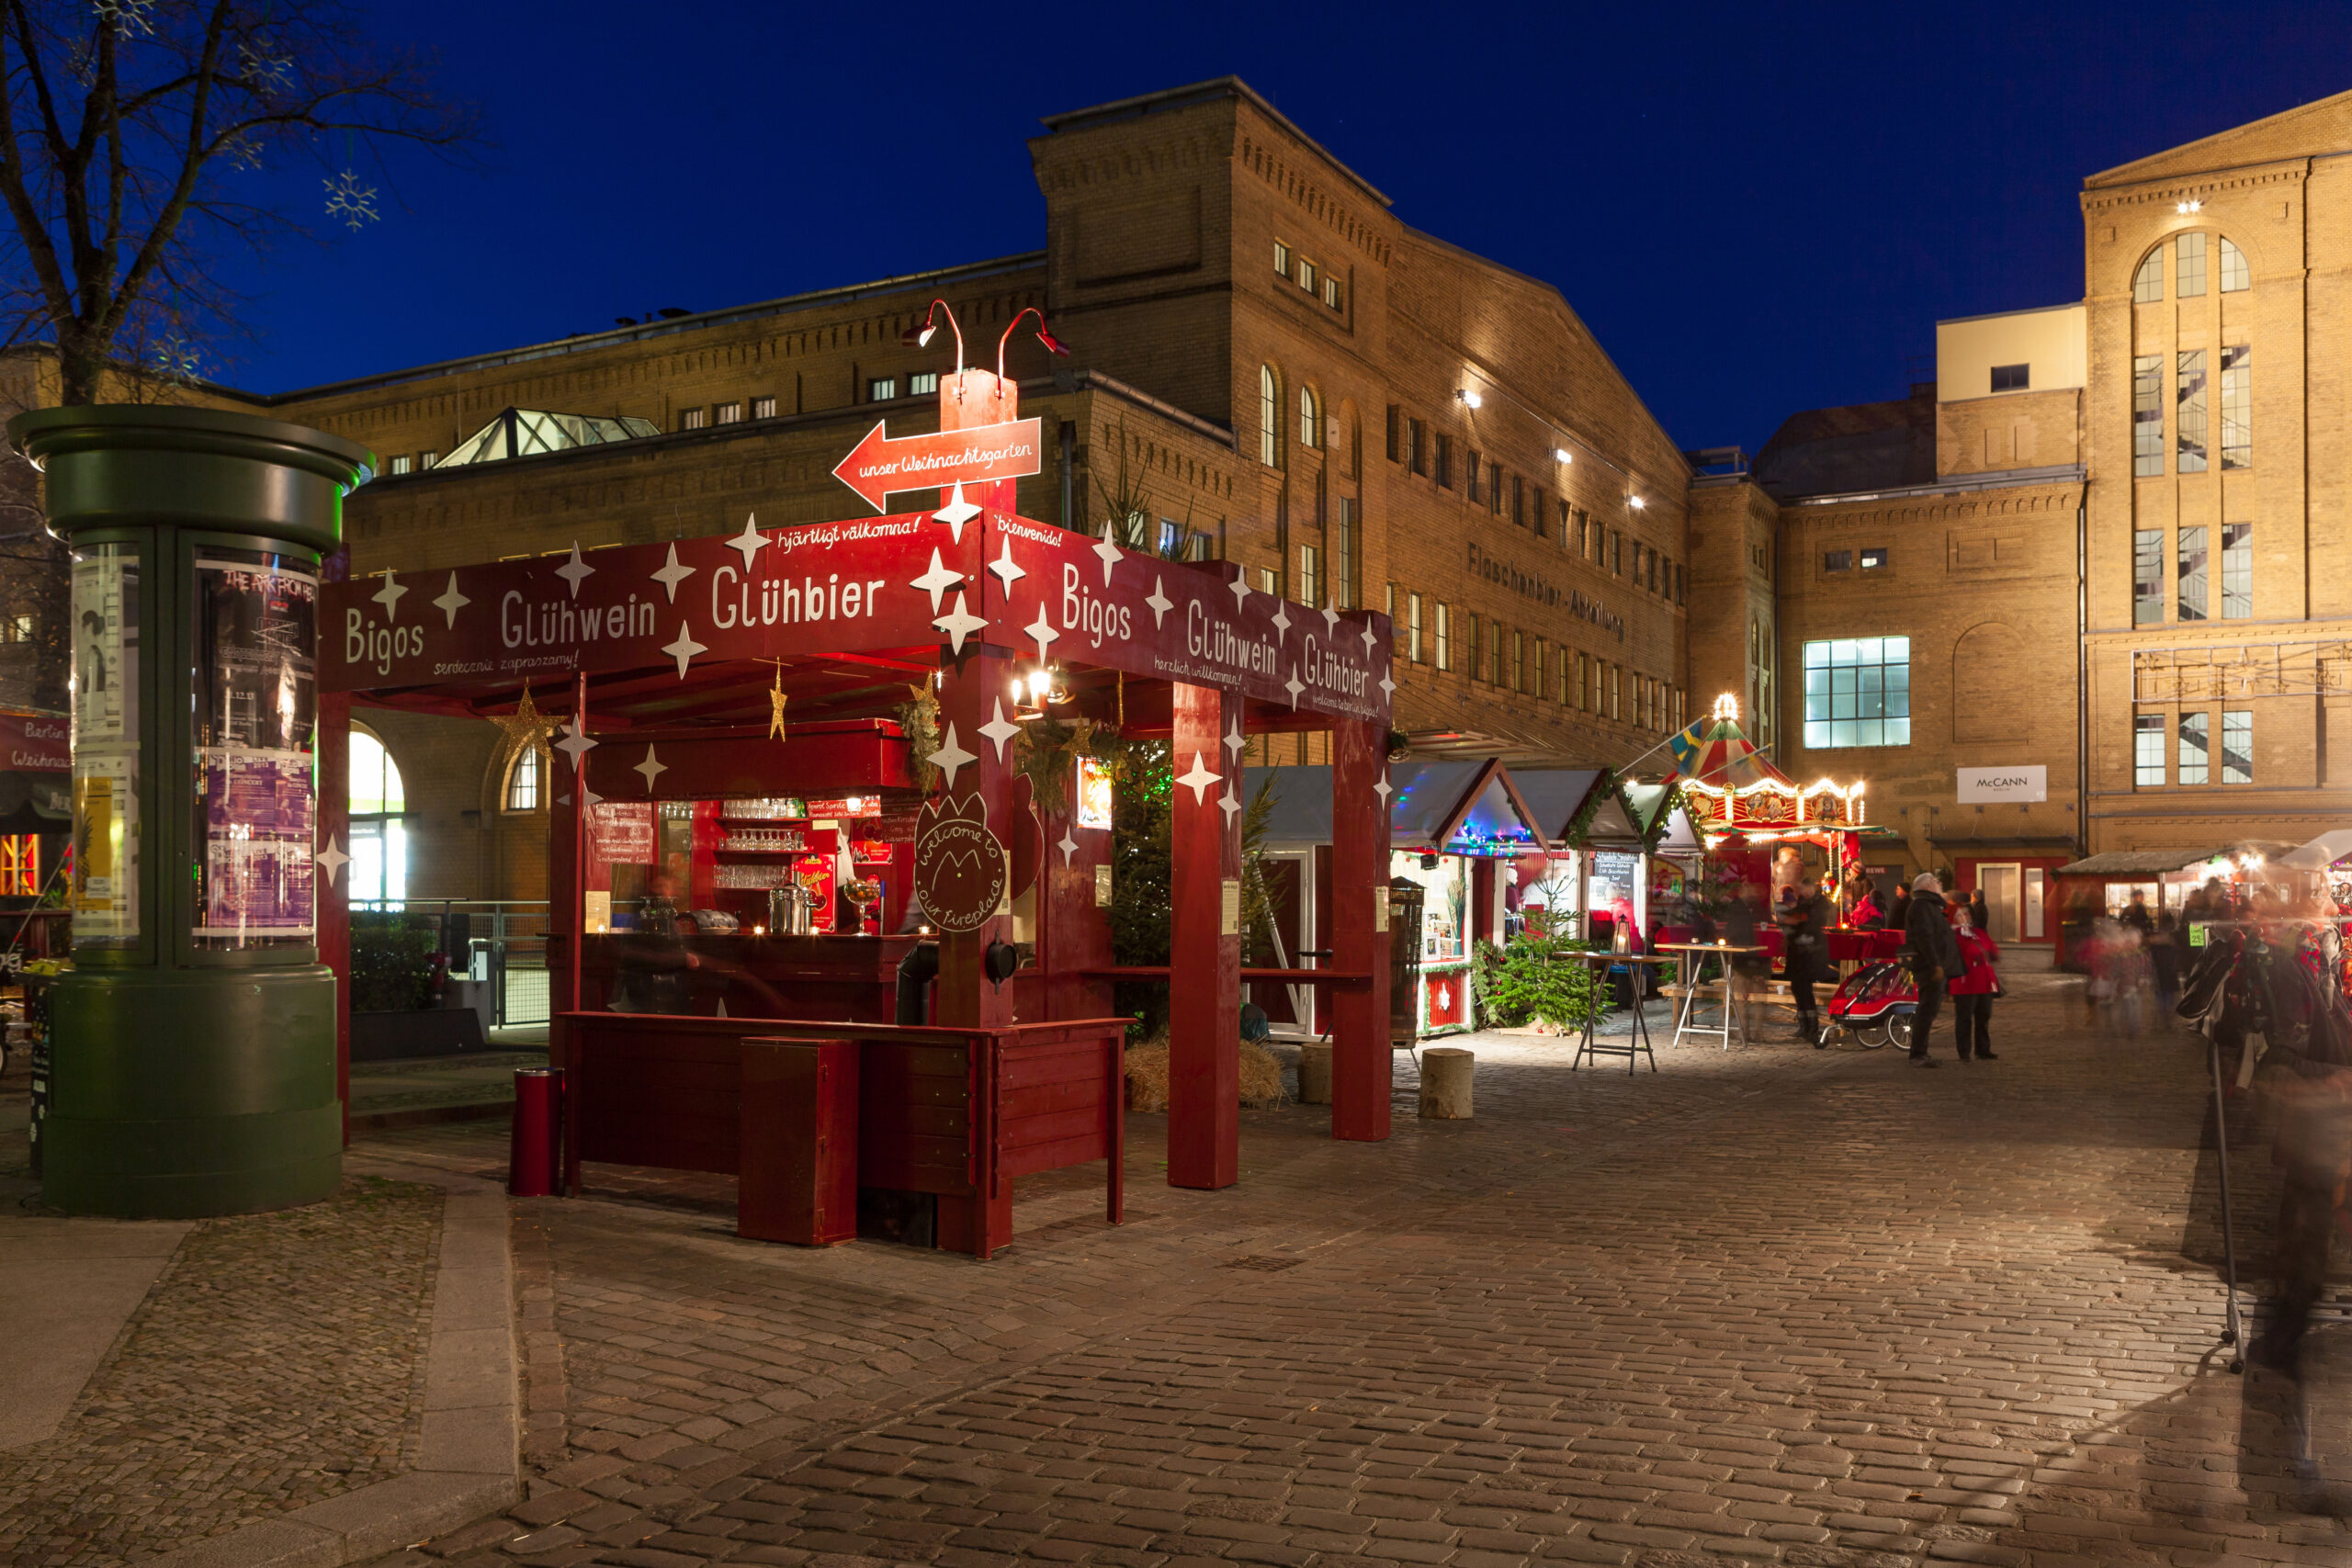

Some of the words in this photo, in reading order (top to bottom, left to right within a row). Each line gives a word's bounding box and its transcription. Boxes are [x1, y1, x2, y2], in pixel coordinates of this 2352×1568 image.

[859, 464, 899, 478] unser
[901, 443, 1033, 473] Weihnachtsgarten
[777, 528, 840, 554] hjärtligt
[842, 516, 922, 540] välkomna!
[997, 514, 1063, 547] bienvenido!
[502, 590, 655, 649] Glühwein
[712, 566, 885, 629] Glühbier
[1062, 562, 1131, 649] Bigos
[346, 607, 424, 676] Bigos
[1187, 598, 1276, 675] Glühwein
[434, 659, 494, 675] serdecznie
[500, 649, 580, 673] zapraszamy!
[1154, 654, 1191, 676] herzlich
[1191, 665, 1243, 685] willkommen!
[1305, 633, 1370, 698] Glühbier
[1976, 777, 2028, 787] McCANN
[921, 826, 981, 866] welcome
[985, 837, 998, 858] to
[919, 889, 942, 915] our
[943, 878, 1002, 926] fireplace
